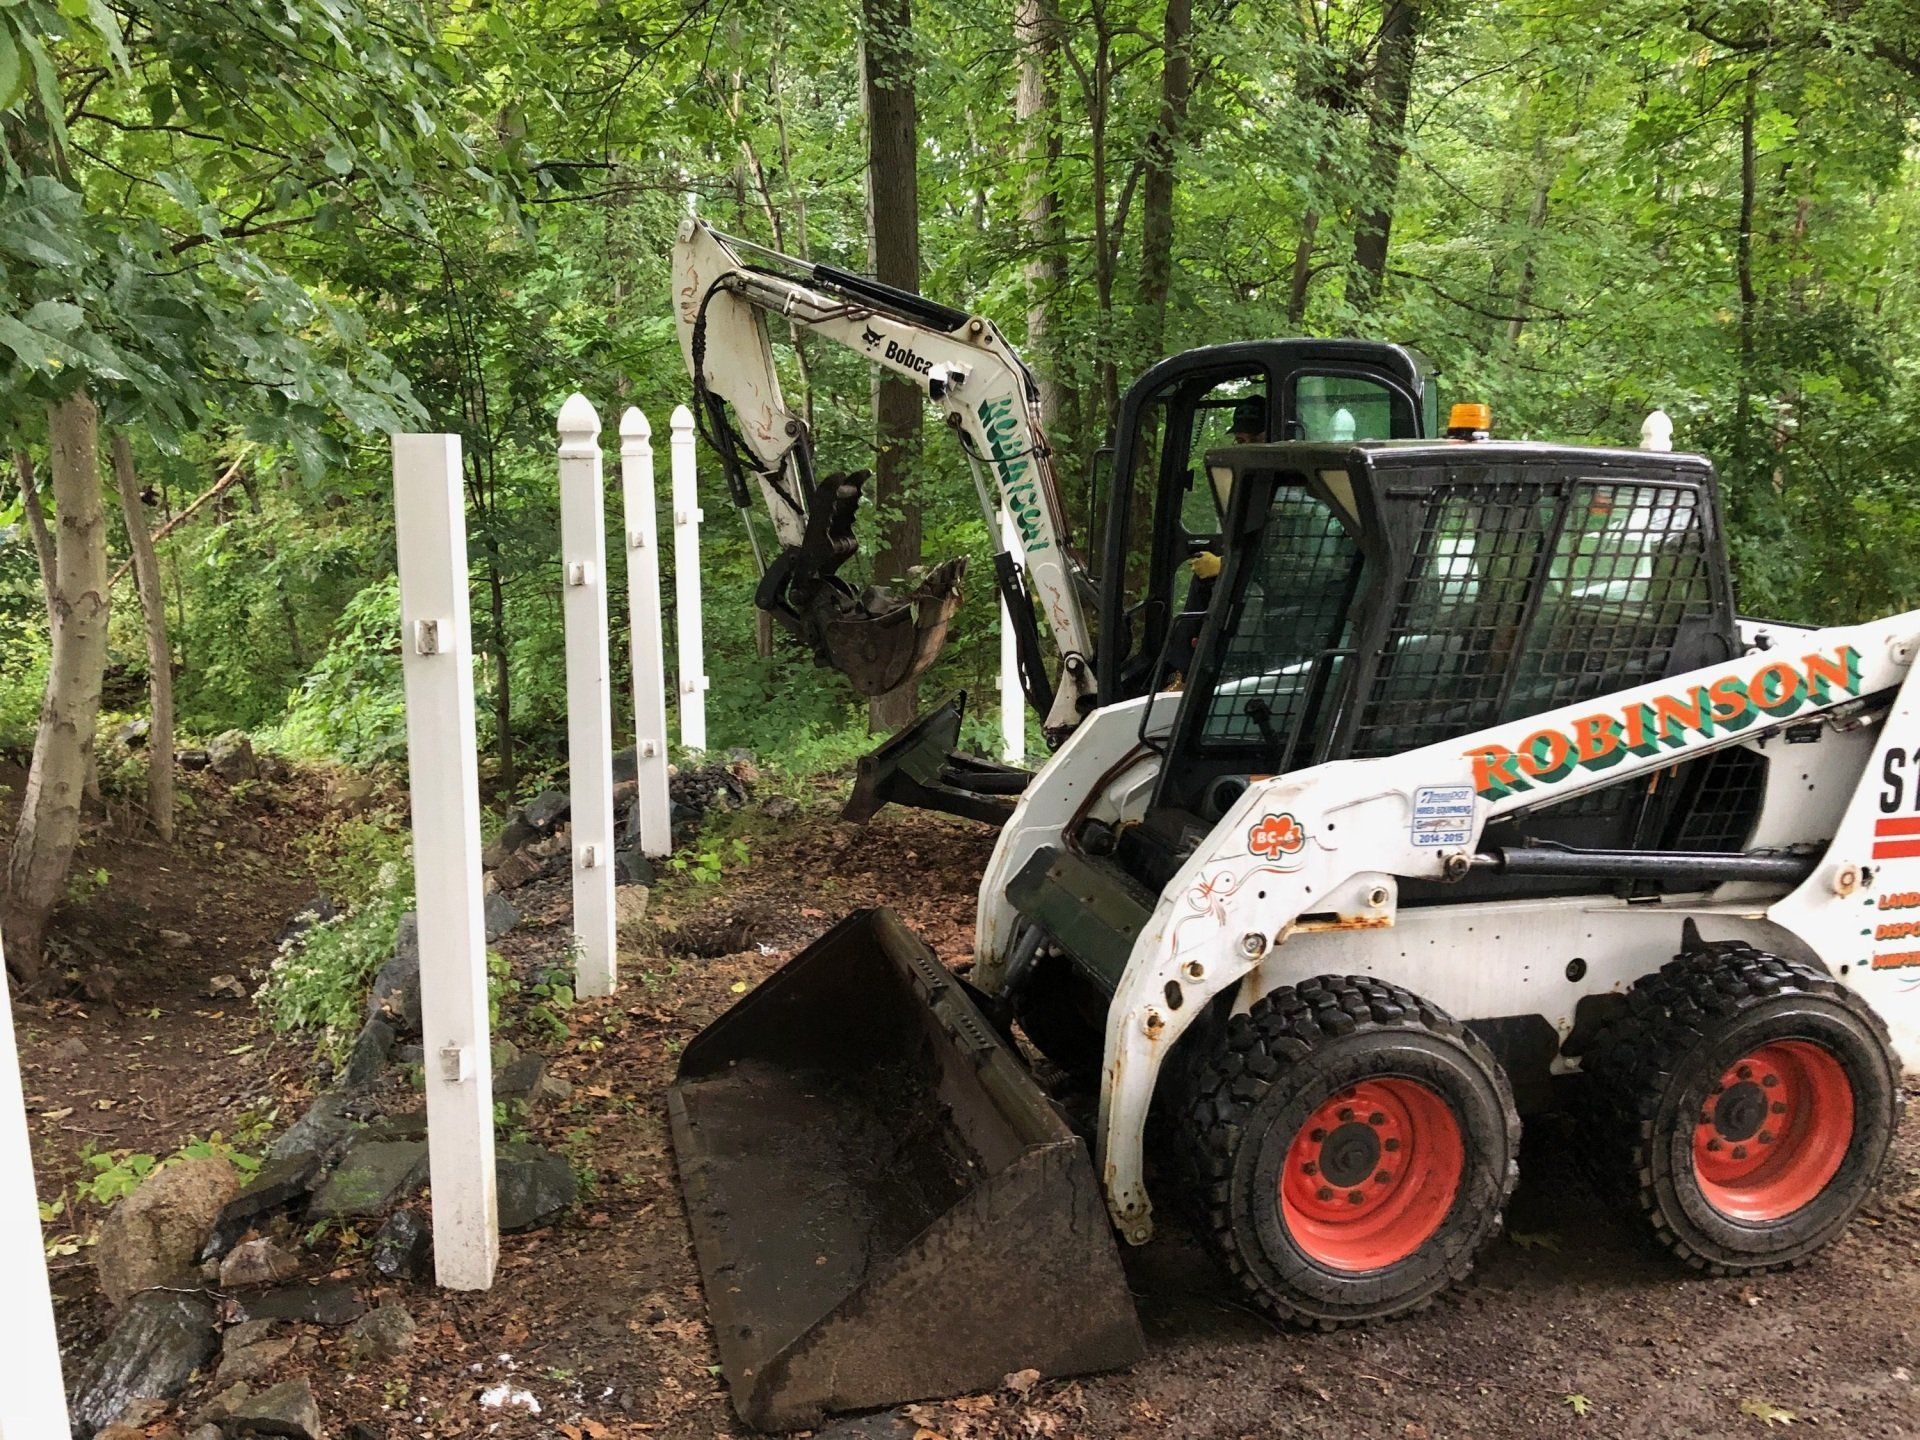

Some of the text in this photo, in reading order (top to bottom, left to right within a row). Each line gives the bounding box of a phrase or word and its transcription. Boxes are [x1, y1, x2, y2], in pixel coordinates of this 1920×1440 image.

[885, 340, 934, 376] Bobca
[977, 391, 1050, 553] ROBINSON
[1462, 645, 1863, 802] ROBINSON
